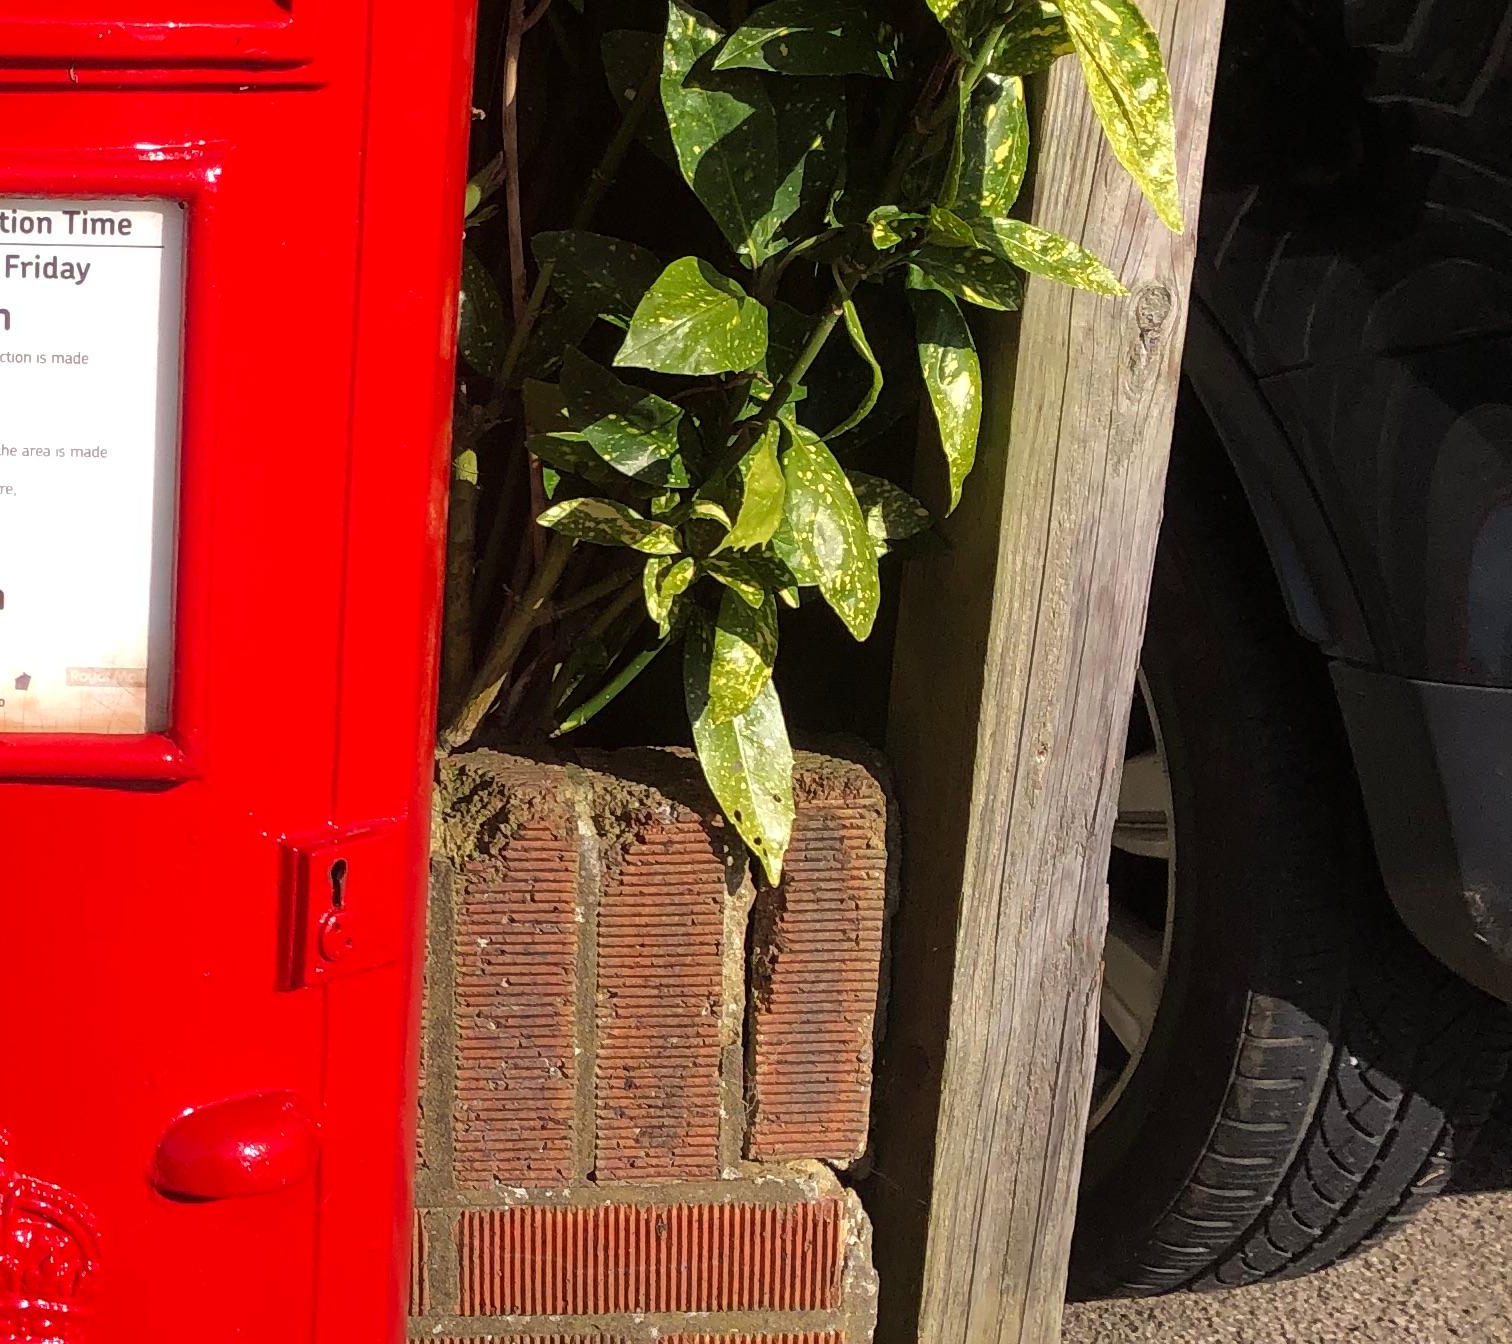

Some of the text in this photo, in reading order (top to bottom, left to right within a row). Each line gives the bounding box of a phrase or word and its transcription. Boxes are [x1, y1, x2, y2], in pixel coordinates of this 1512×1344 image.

[62, 209, 132, 236] Time
[5, 254, 91, 285] Friday
[36, 353, 47, 364] is
[51, 352, 89, 365] made
[21, 447, 51, 457] area
[56, 447, 65, 458] is
[70, 446, 108, 458] made
